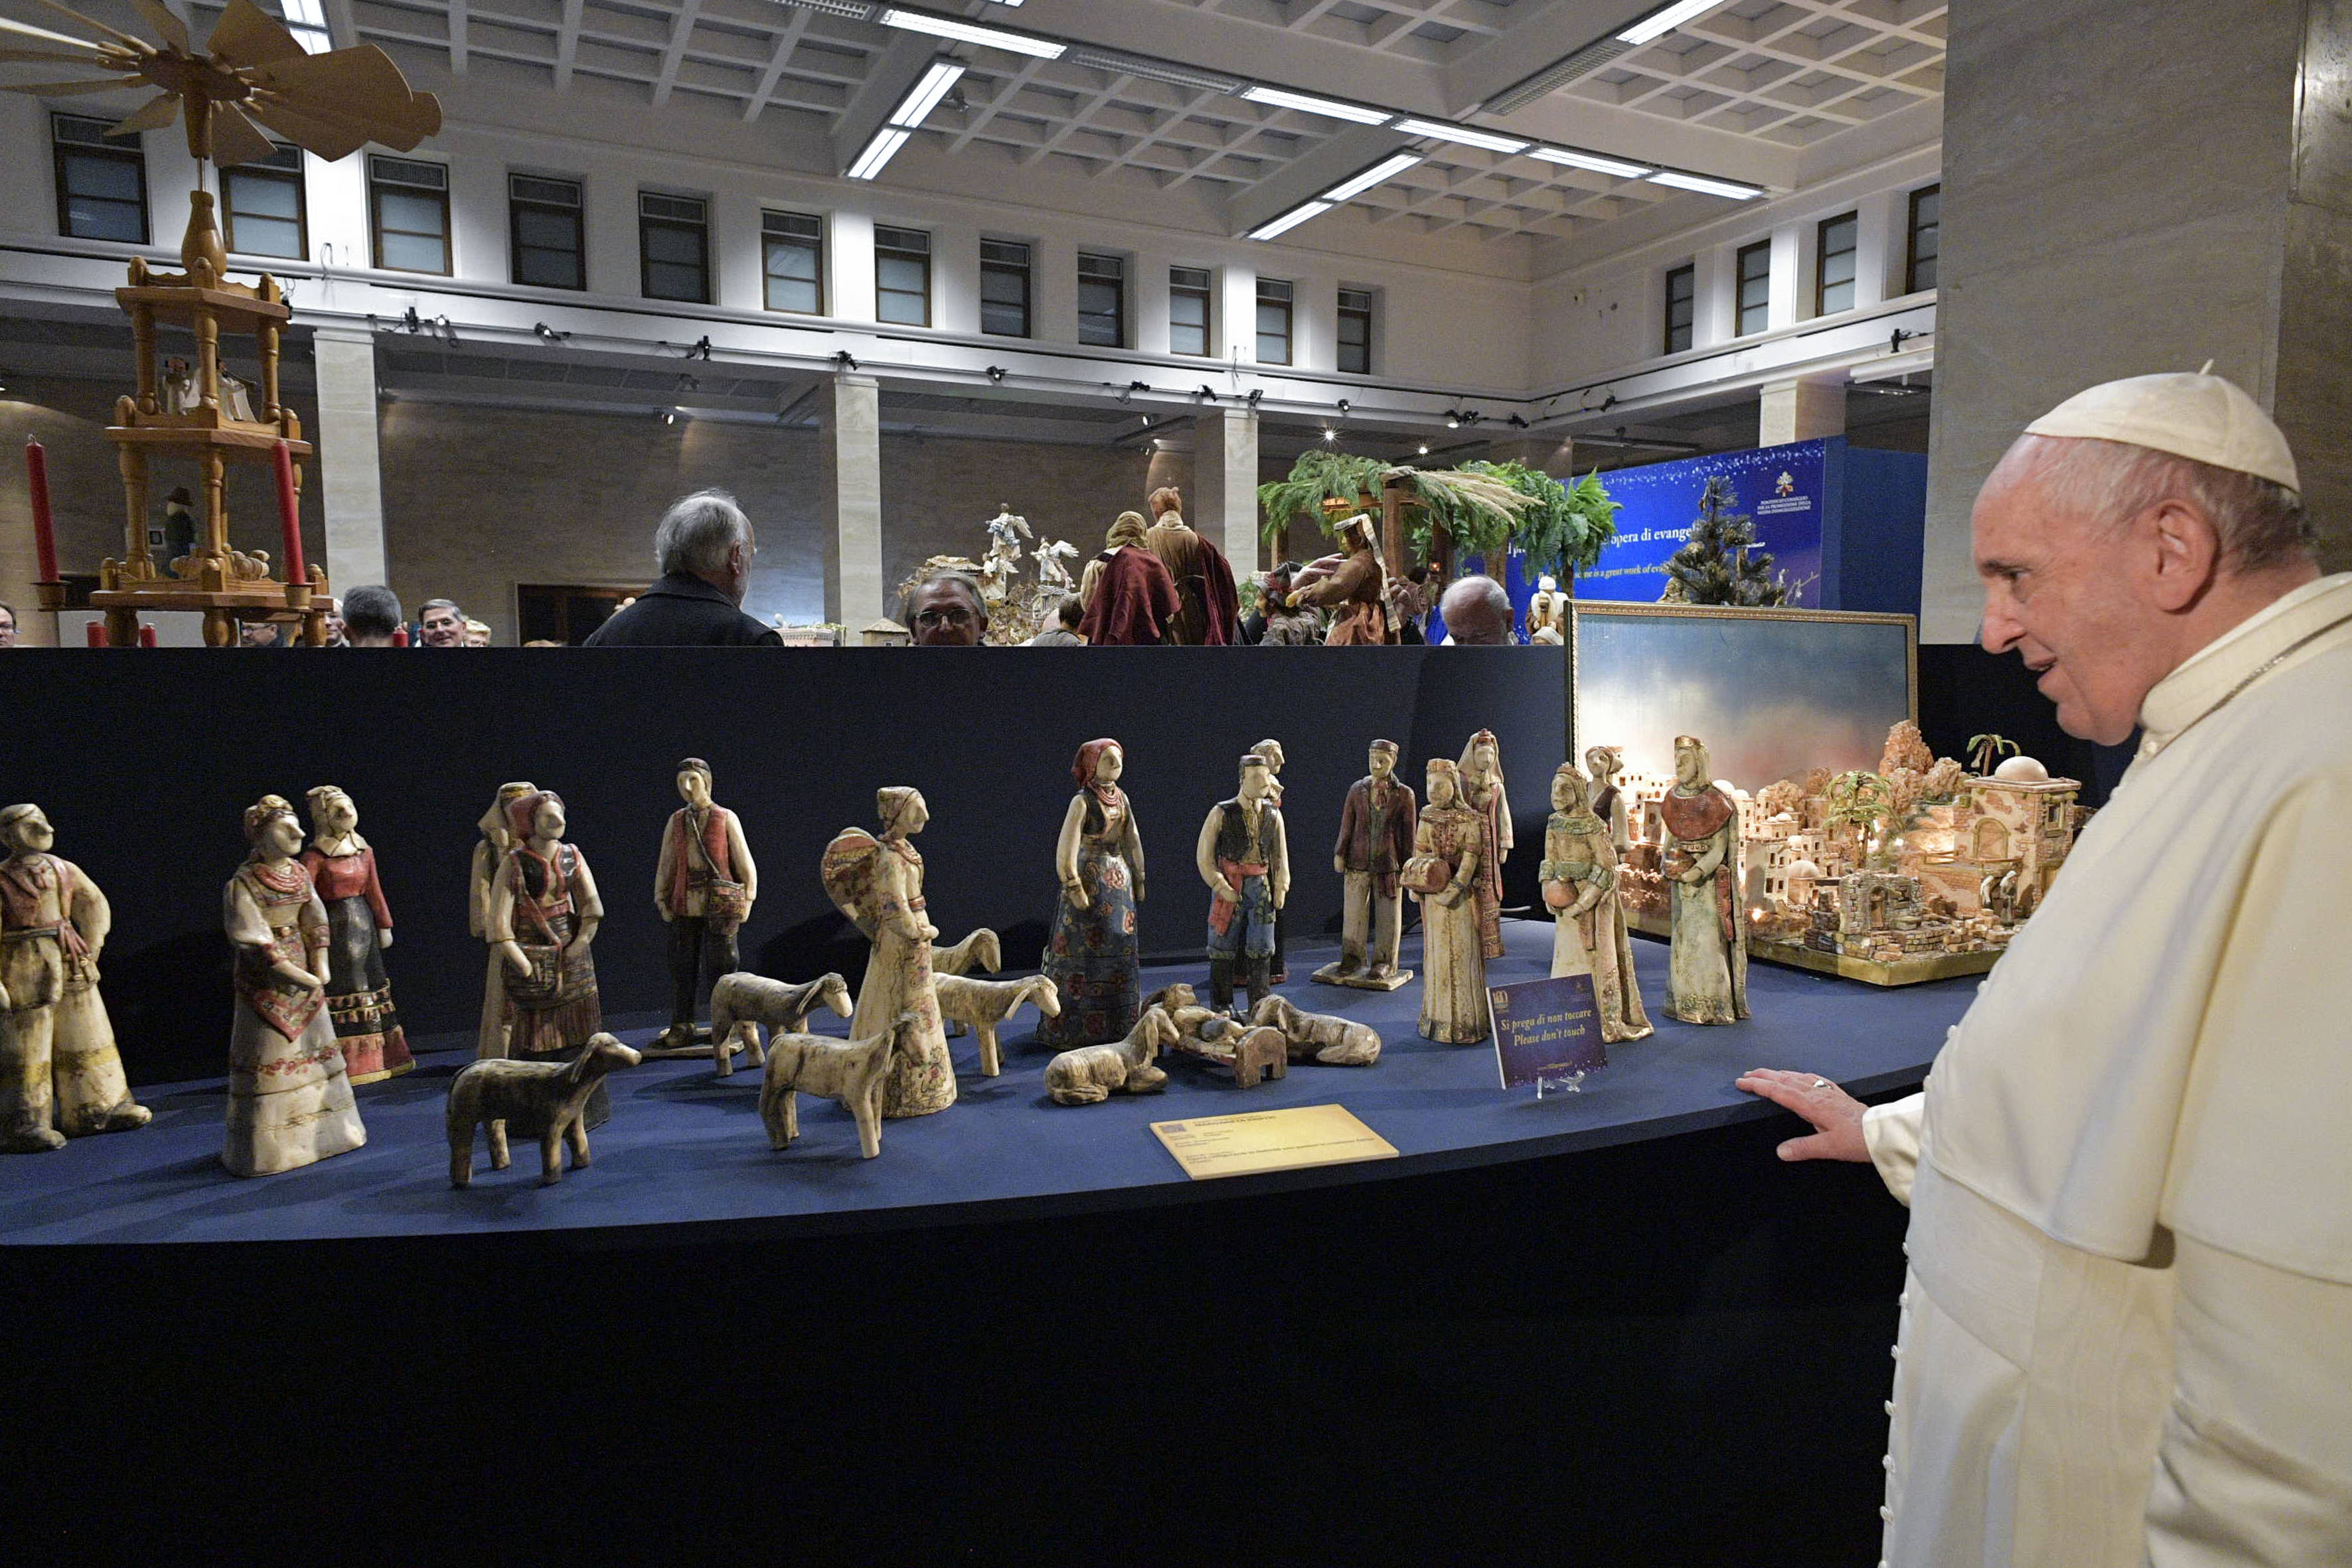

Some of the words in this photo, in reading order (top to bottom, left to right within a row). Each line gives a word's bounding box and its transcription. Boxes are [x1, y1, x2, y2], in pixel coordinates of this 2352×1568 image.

[1611, 534, 1639, 548] opera
[1641, 528, 1652, 541] di
[1606, 570, 1622, 580] great
[1642, 564, 1652, 574] of
[1501, 1019, 1510, 1031] Si
[1537, 1013, 1545, 1025] di
[1547, 1014, 1563, 1023] non
[1565, 1010, 1592, 1020] toccare
[1514, 1034, 1539, 1046] Please
[1541, 1028, 1562, 1041] don't
[1564, 1024, 1585, 1038] touch
